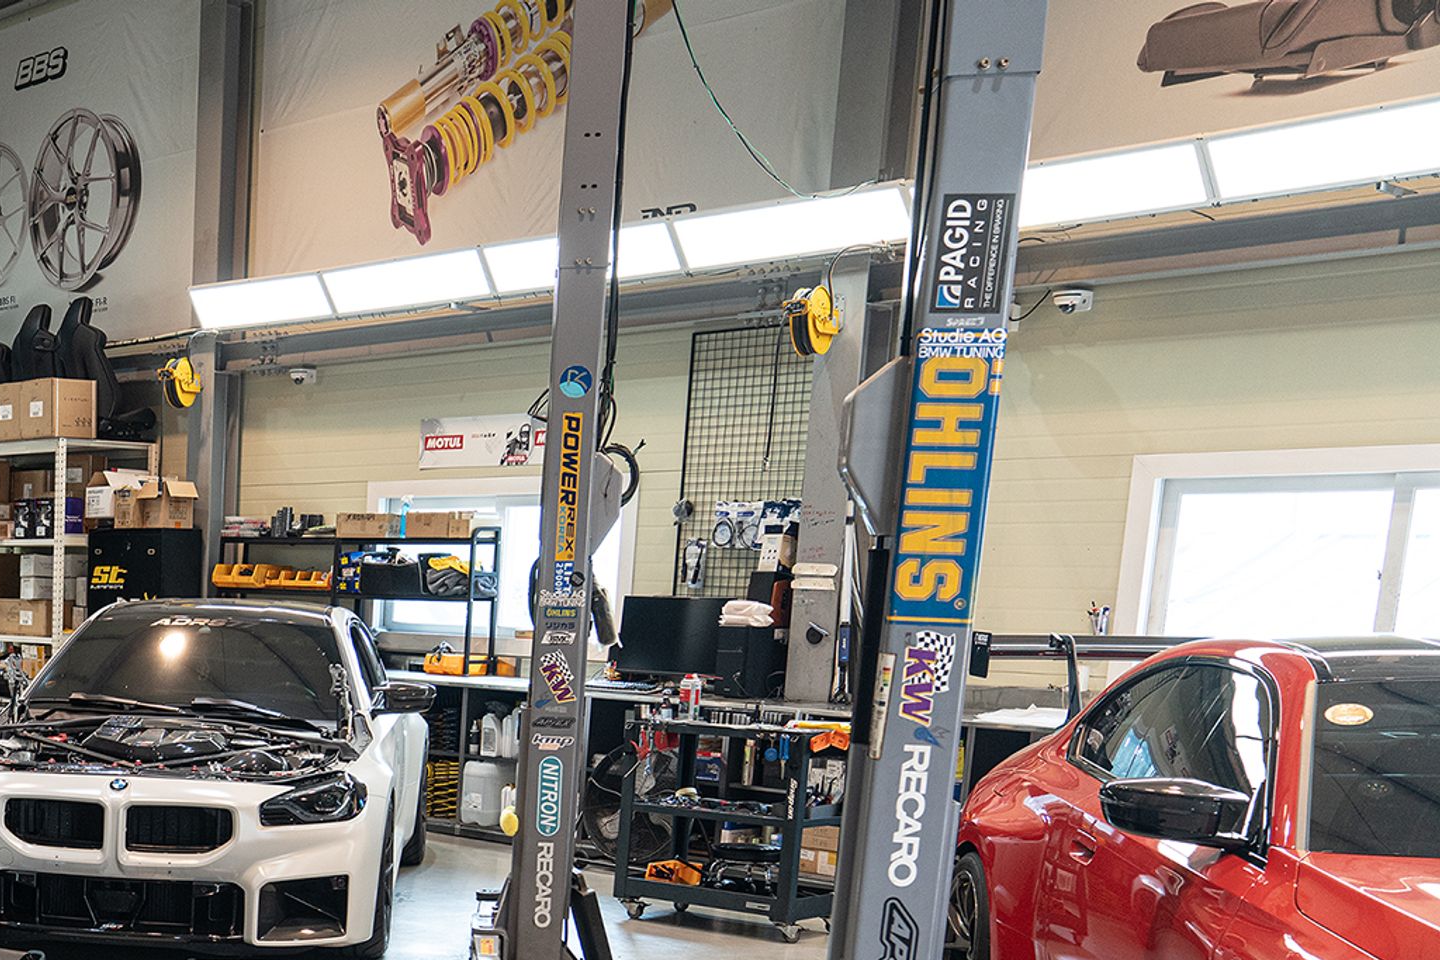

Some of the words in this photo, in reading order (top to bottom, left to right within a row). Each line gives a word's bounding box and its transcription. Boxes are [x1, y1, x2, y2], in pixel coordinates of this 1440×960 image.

[15, 47, 68, 90] BBS
[993, 199, 1004, 235] BRAKING
[939, 199, 972, 281] PAGID
[964, 199, 988, 308] RACING
[992, 235, 999, 243] IN
[985, 245, 999, 292] DIFFERENCE
[983, 292, 992, 308] THE
[918, 346, 952, 358] BMW
[954, 346, 1004, 358] TUNING
[920, 328, 977, 343] Studie
[426, 435, 462, 449] MOTUL
[539, 663, 577, 704] KW
[898, 647, 936, 727] KW
[541, 763, 559, 828] NITRON
[888, 744, 932, 888] RECARO
[534, 842, 554, 928] RECARO
